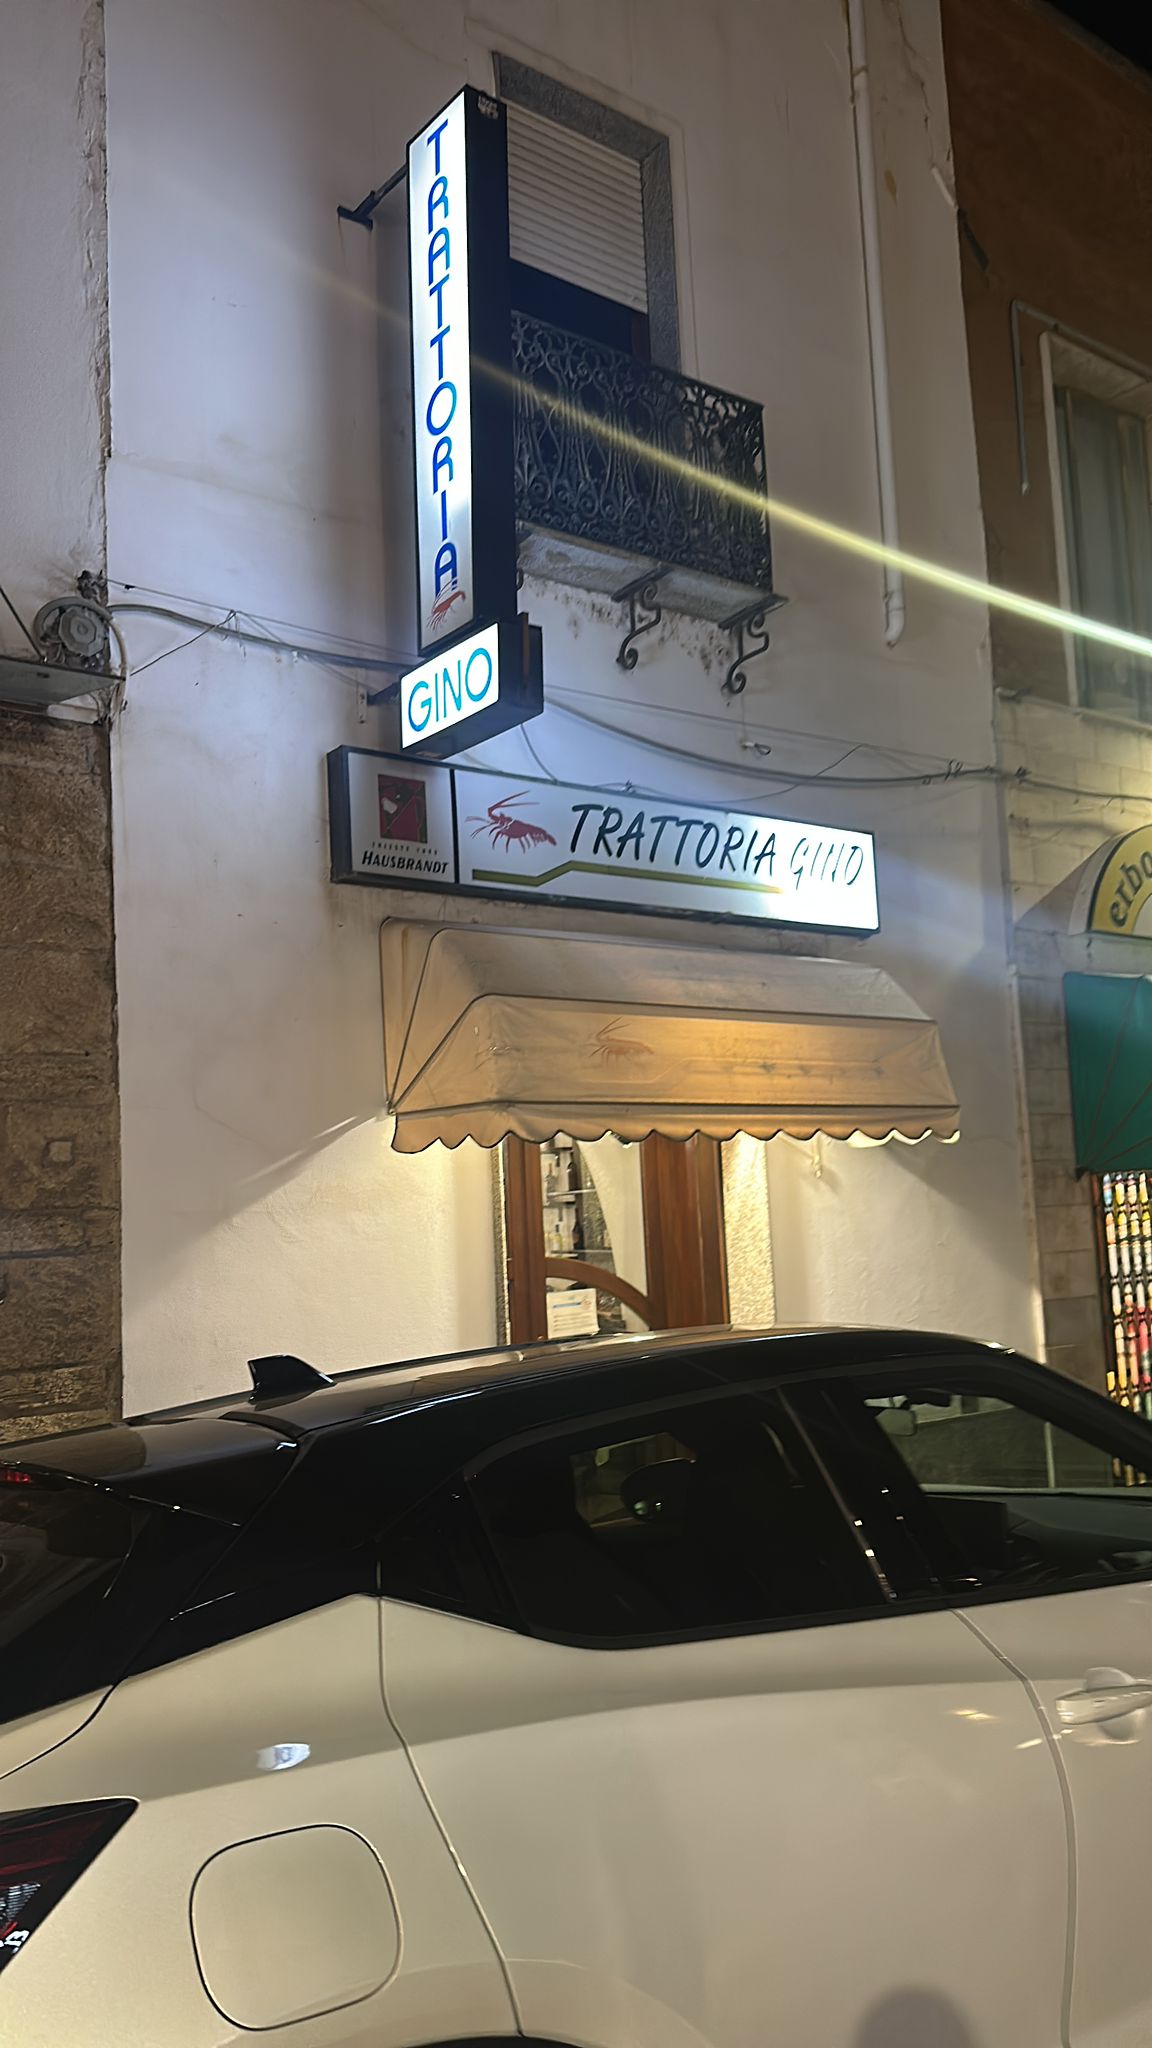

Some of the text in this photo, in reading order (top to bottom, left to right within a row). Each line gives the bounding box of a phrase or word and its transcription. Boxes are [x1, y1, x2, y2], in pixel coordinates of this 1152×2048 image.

[425, 118, 459, 598] TRATTORIA
[407, 647, 493, 733] GINO
[361, 849, 450, 875] HAUSBRANDT
[570, 803, 865, 891] TRATTORIA GINO
